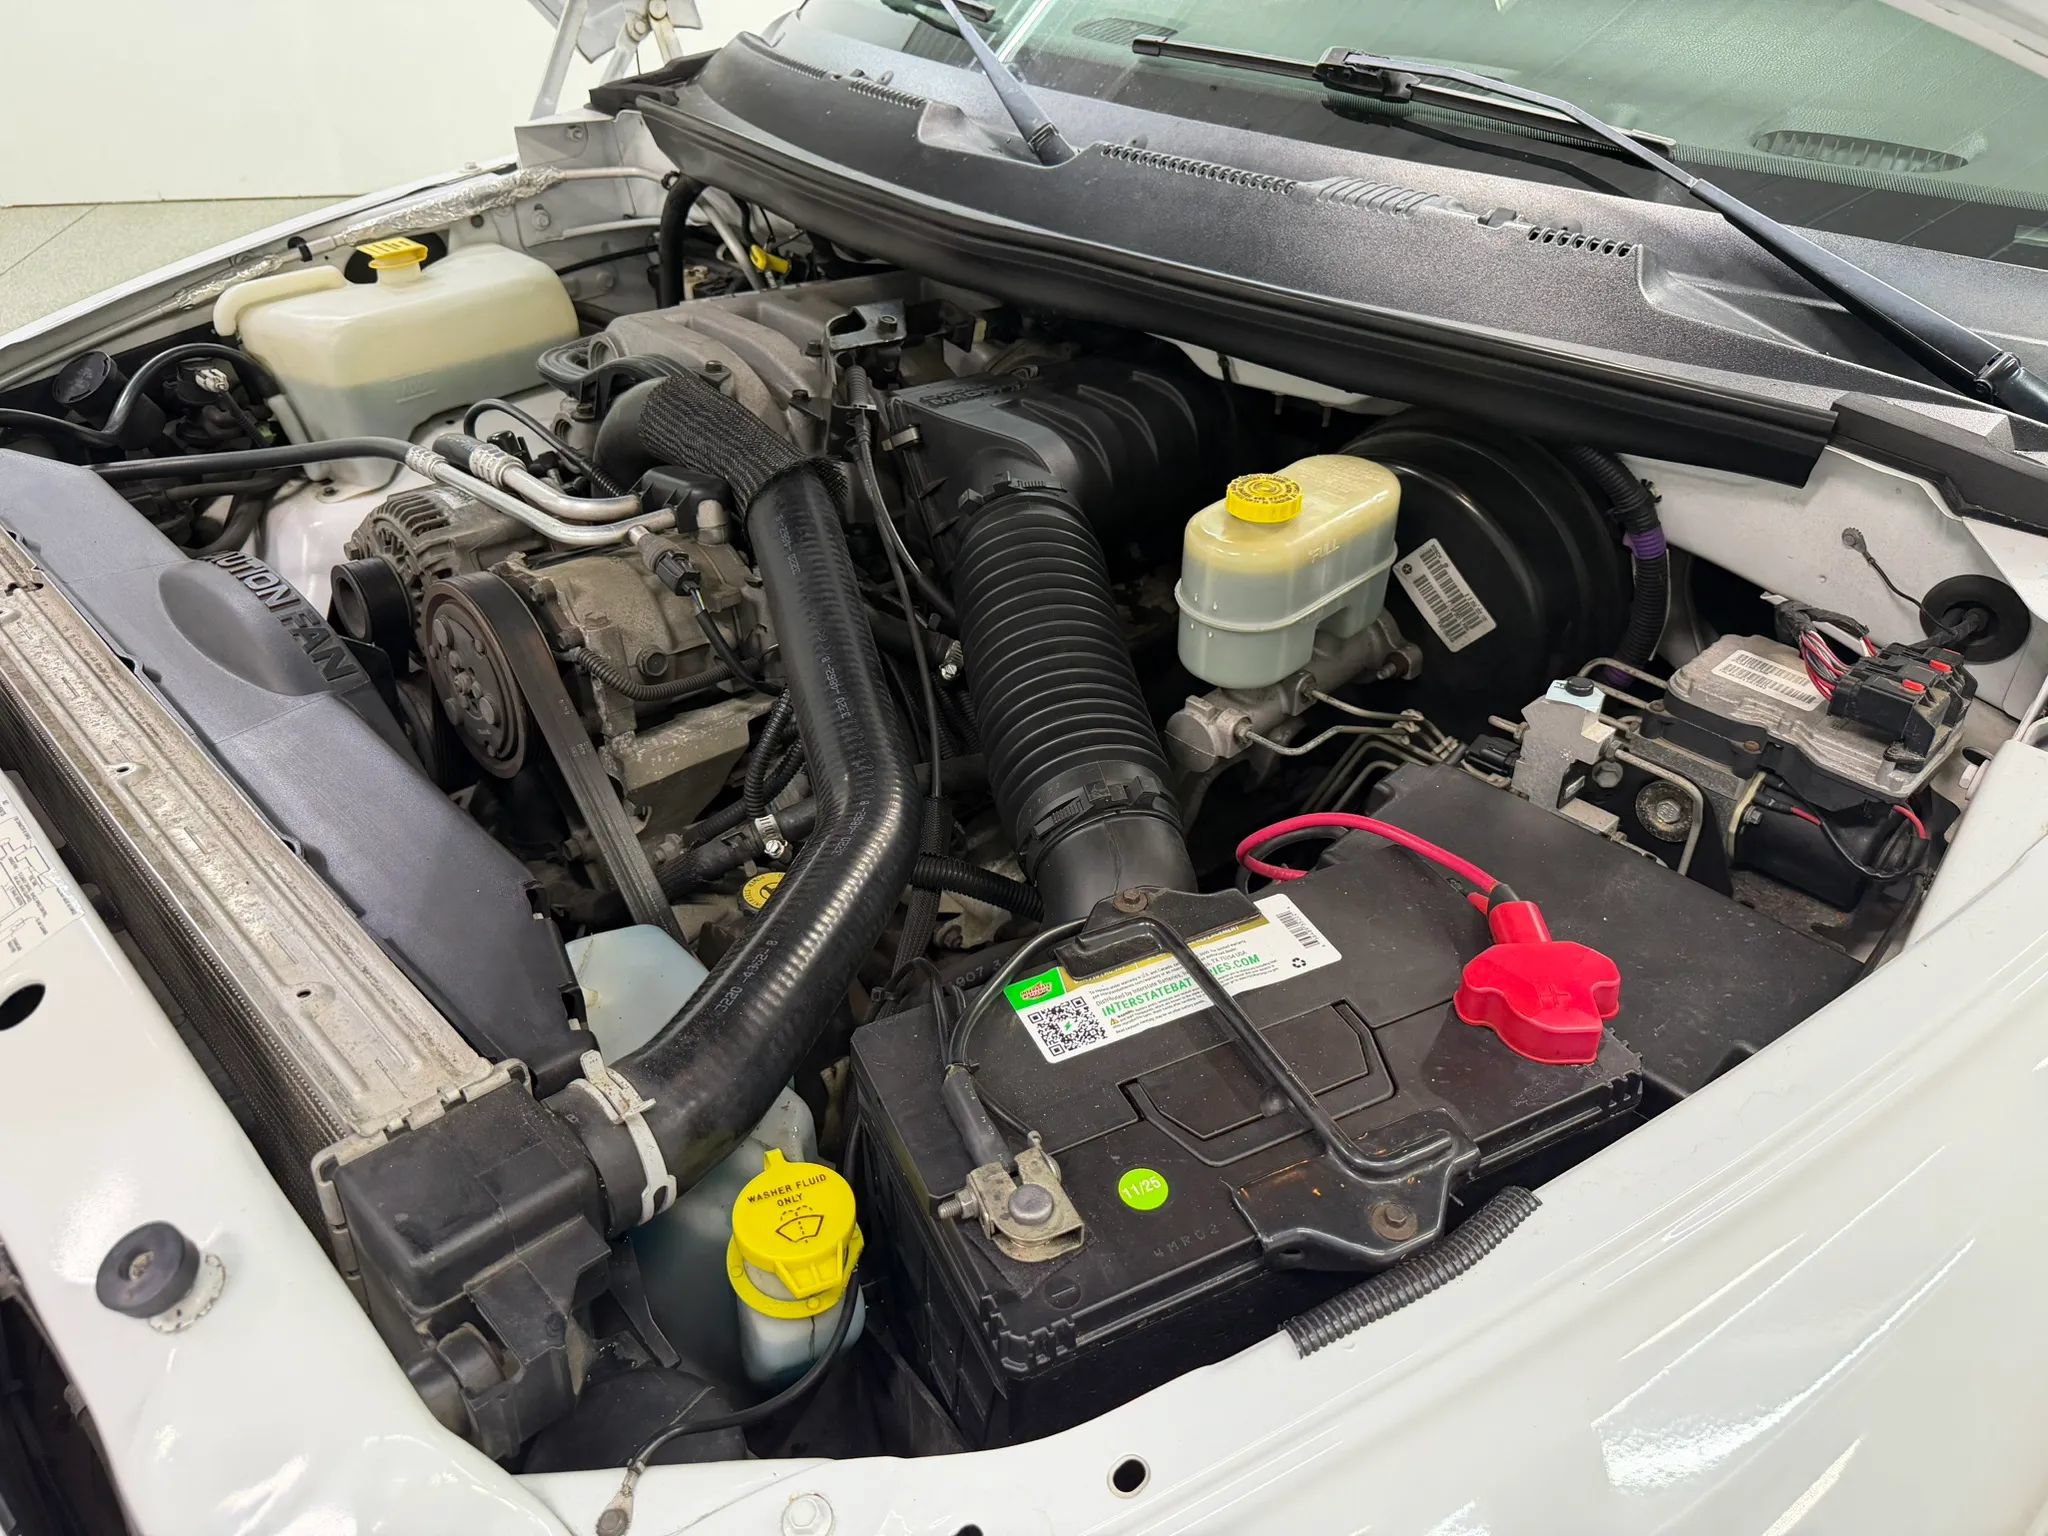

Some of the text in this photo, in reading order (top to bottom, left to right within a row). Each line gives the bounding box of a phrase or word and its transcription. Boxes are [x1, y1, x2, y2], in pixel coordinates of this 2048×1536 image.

[197, 549, 361, 682] AUTION FAN
[1102, 953, 1261, 1017] INTERSTATEBATIES.COM
[747, 1173, 827, 1203] WASHER FLUID
[776, 1193, 803, 1207] ONLY
[1121, 1176, 1162, 1200] 11/25
